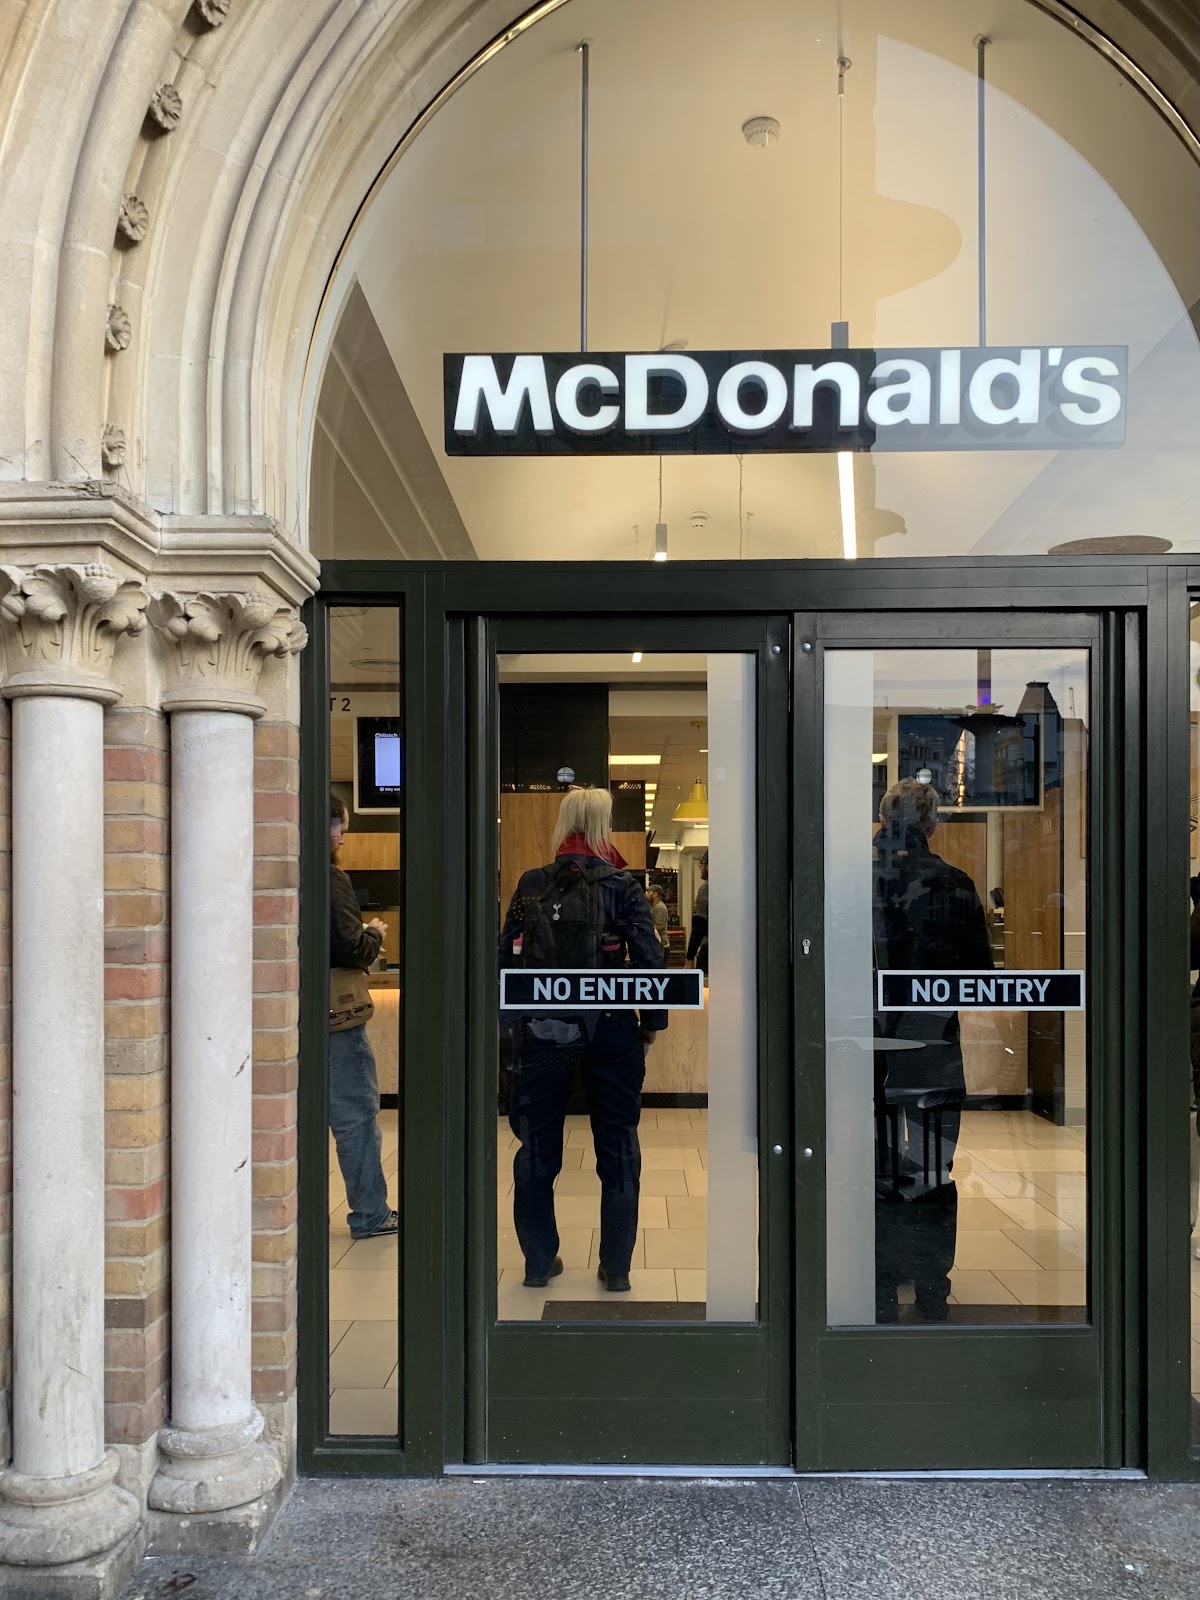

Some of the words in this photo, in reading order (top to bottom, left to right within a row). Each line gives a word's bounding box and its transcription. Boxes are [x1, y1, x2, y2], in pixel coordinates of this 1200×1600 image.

[453, 349, 1122, 432] McDonald's
[341, 697, 351, 711] 2
[533, 977, 571, 1001] NO
[579, 977, 670, 1001] ENTRY
[911, 978, 950, 1003] NO
[959, 978, 1051, 1003] ENTRY
